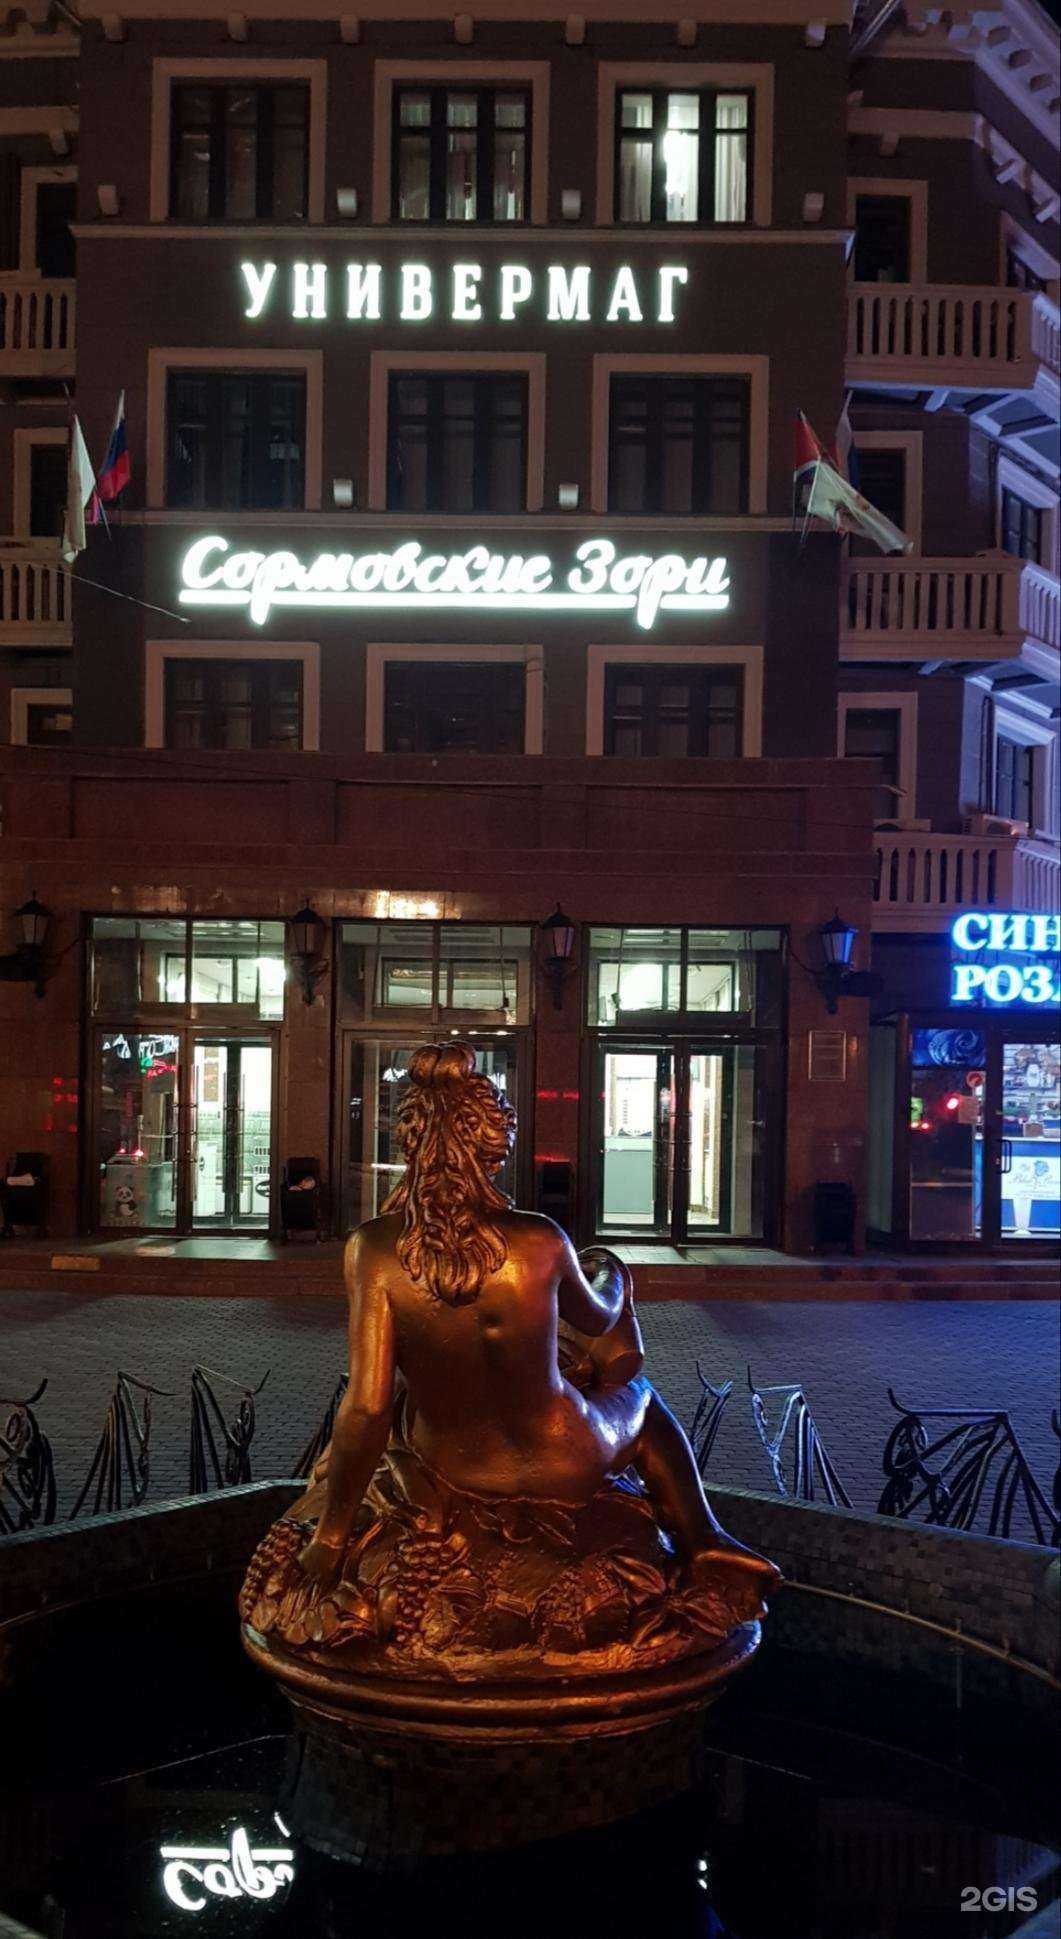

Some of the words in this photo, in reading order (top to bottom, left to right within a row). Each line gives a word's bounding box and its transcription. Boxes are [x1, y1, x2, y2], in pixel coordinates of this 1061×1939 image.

[241, 262, 689, 322] УНИВЕРМАГ
[182, 535, 554, 626] Сормовские
[567, 539, 731, 630] Зори
[951, 964, 1061, 1003] РОЗ
